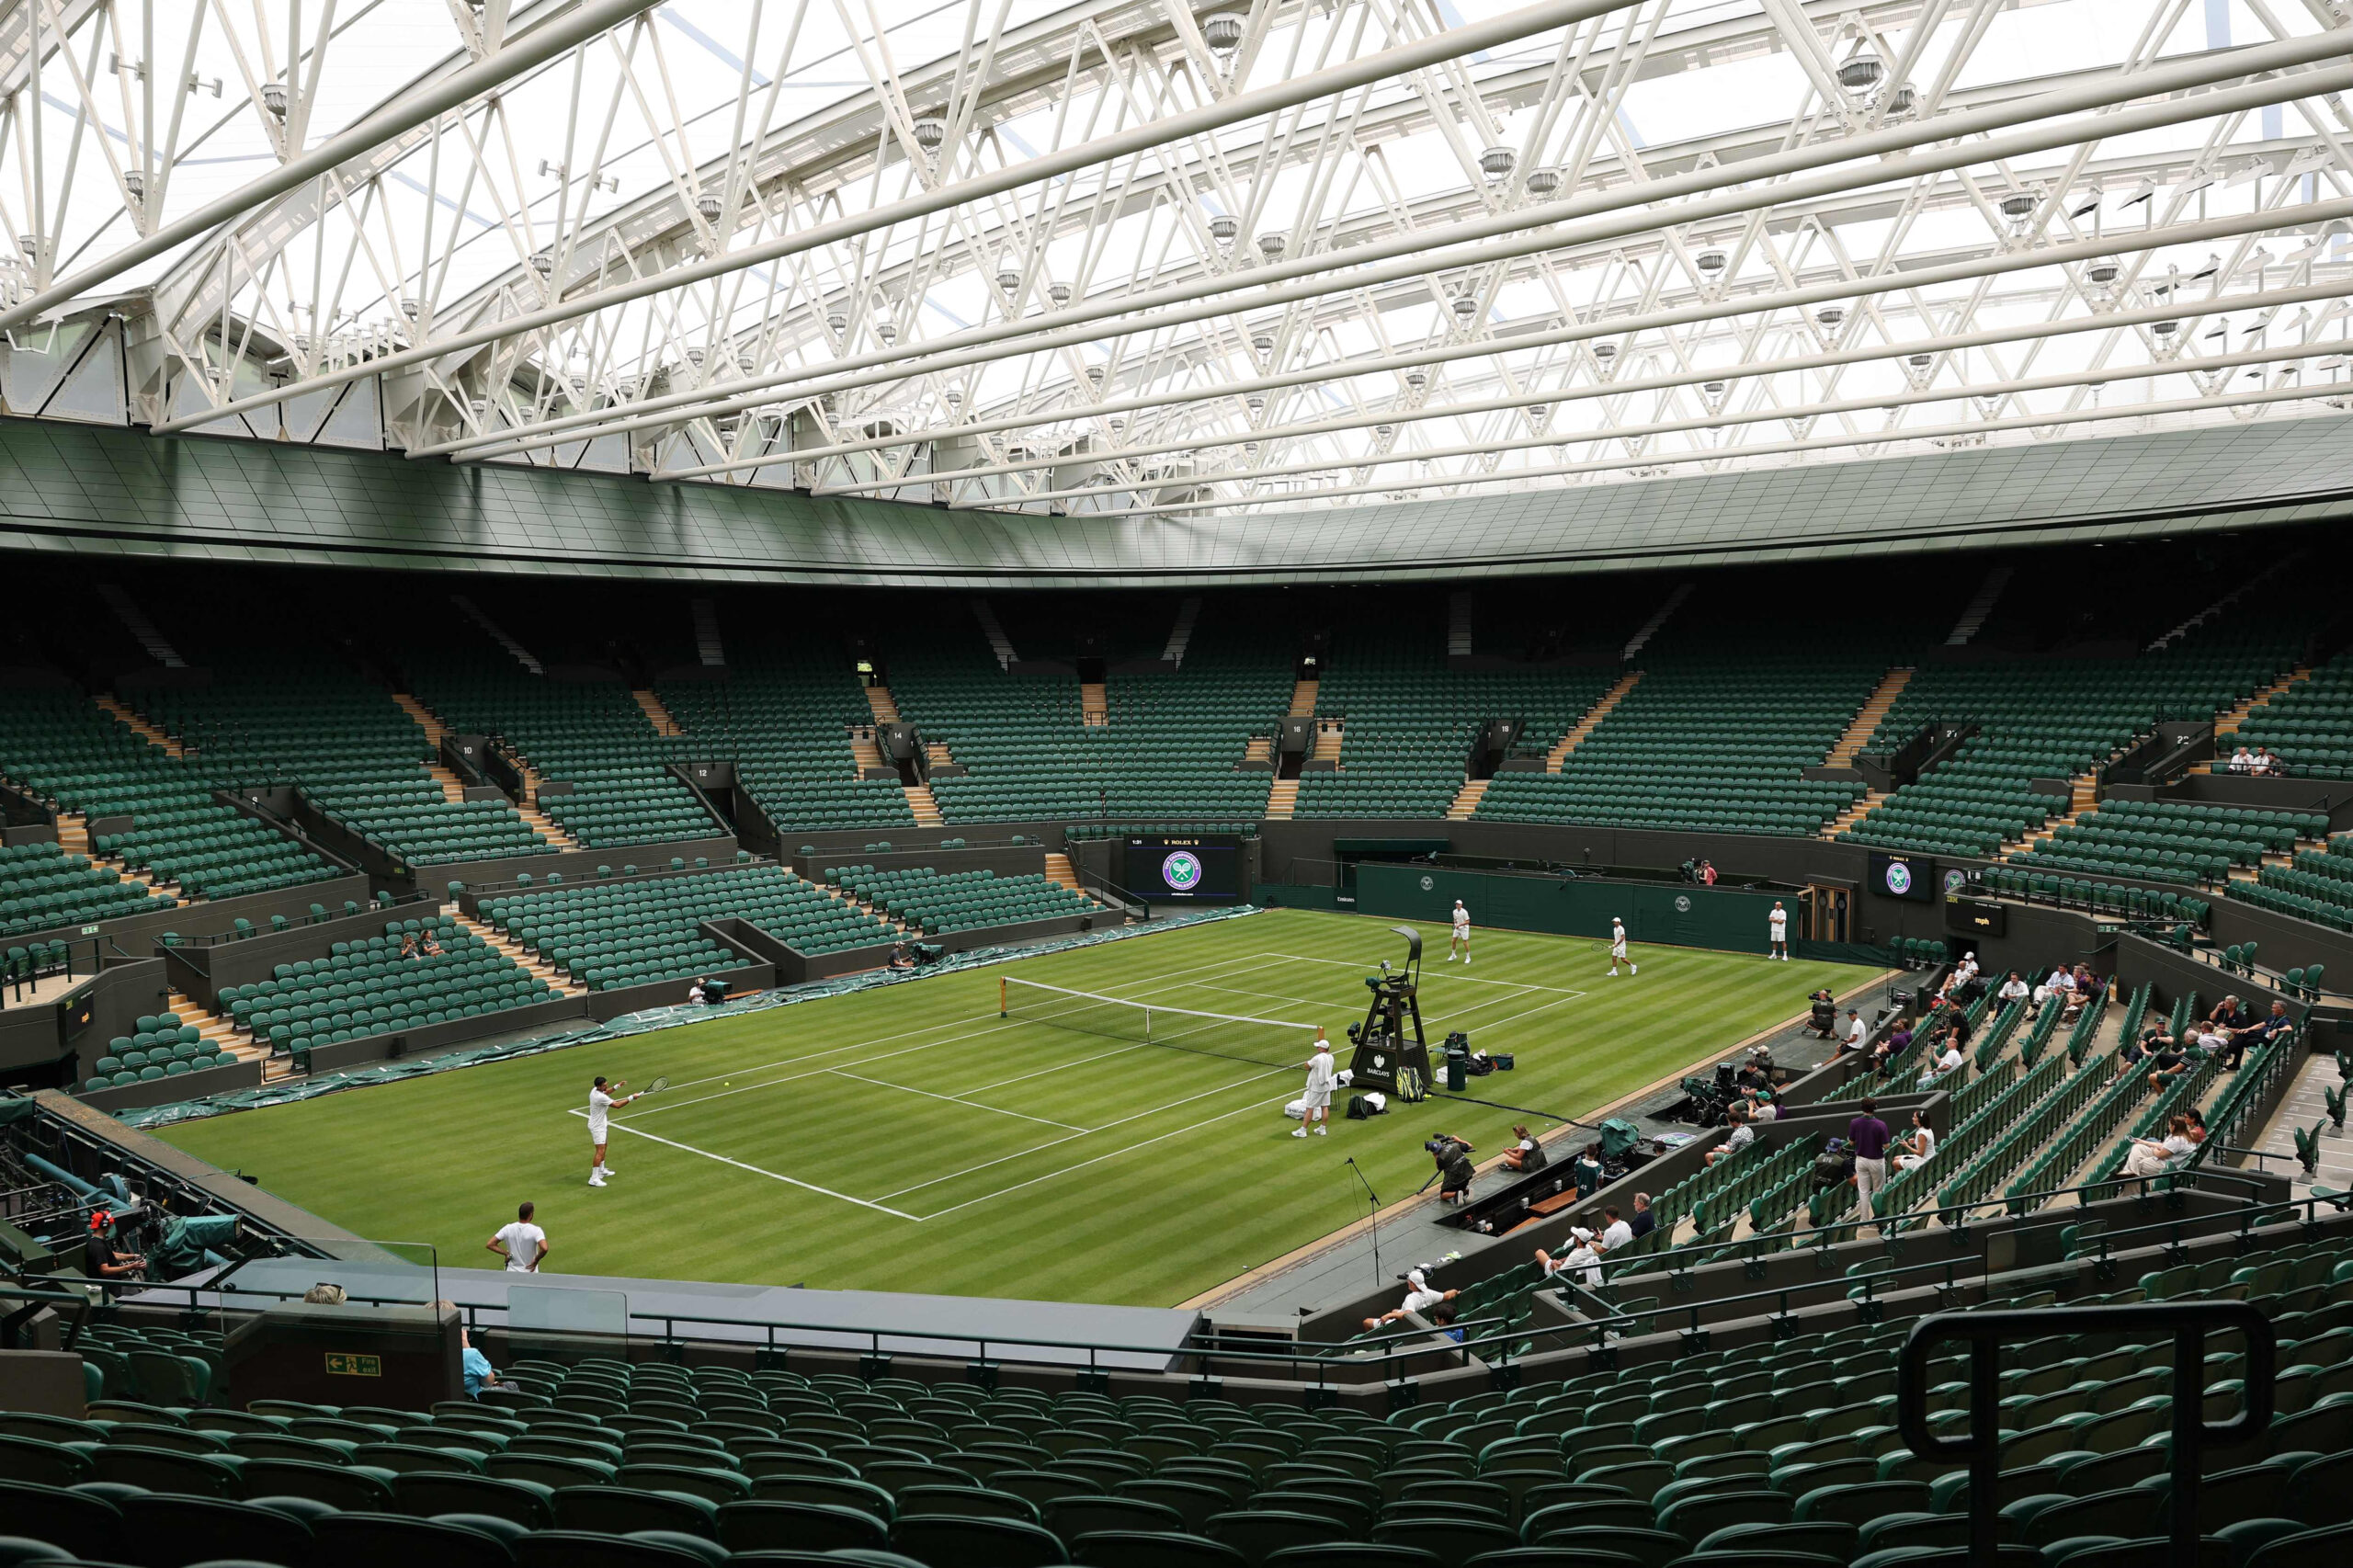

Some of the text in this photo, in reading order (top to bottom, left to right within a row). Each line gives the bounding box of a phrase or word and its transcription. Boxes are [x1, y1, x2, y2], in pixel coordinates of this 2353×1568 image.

[463, 746, 472, 755] 10
[1946, 895, 1959, 903] IBM
[1974, 917, 1990, 926] mph
[1367, 1067, 1390, 1078] BARCLAYS
